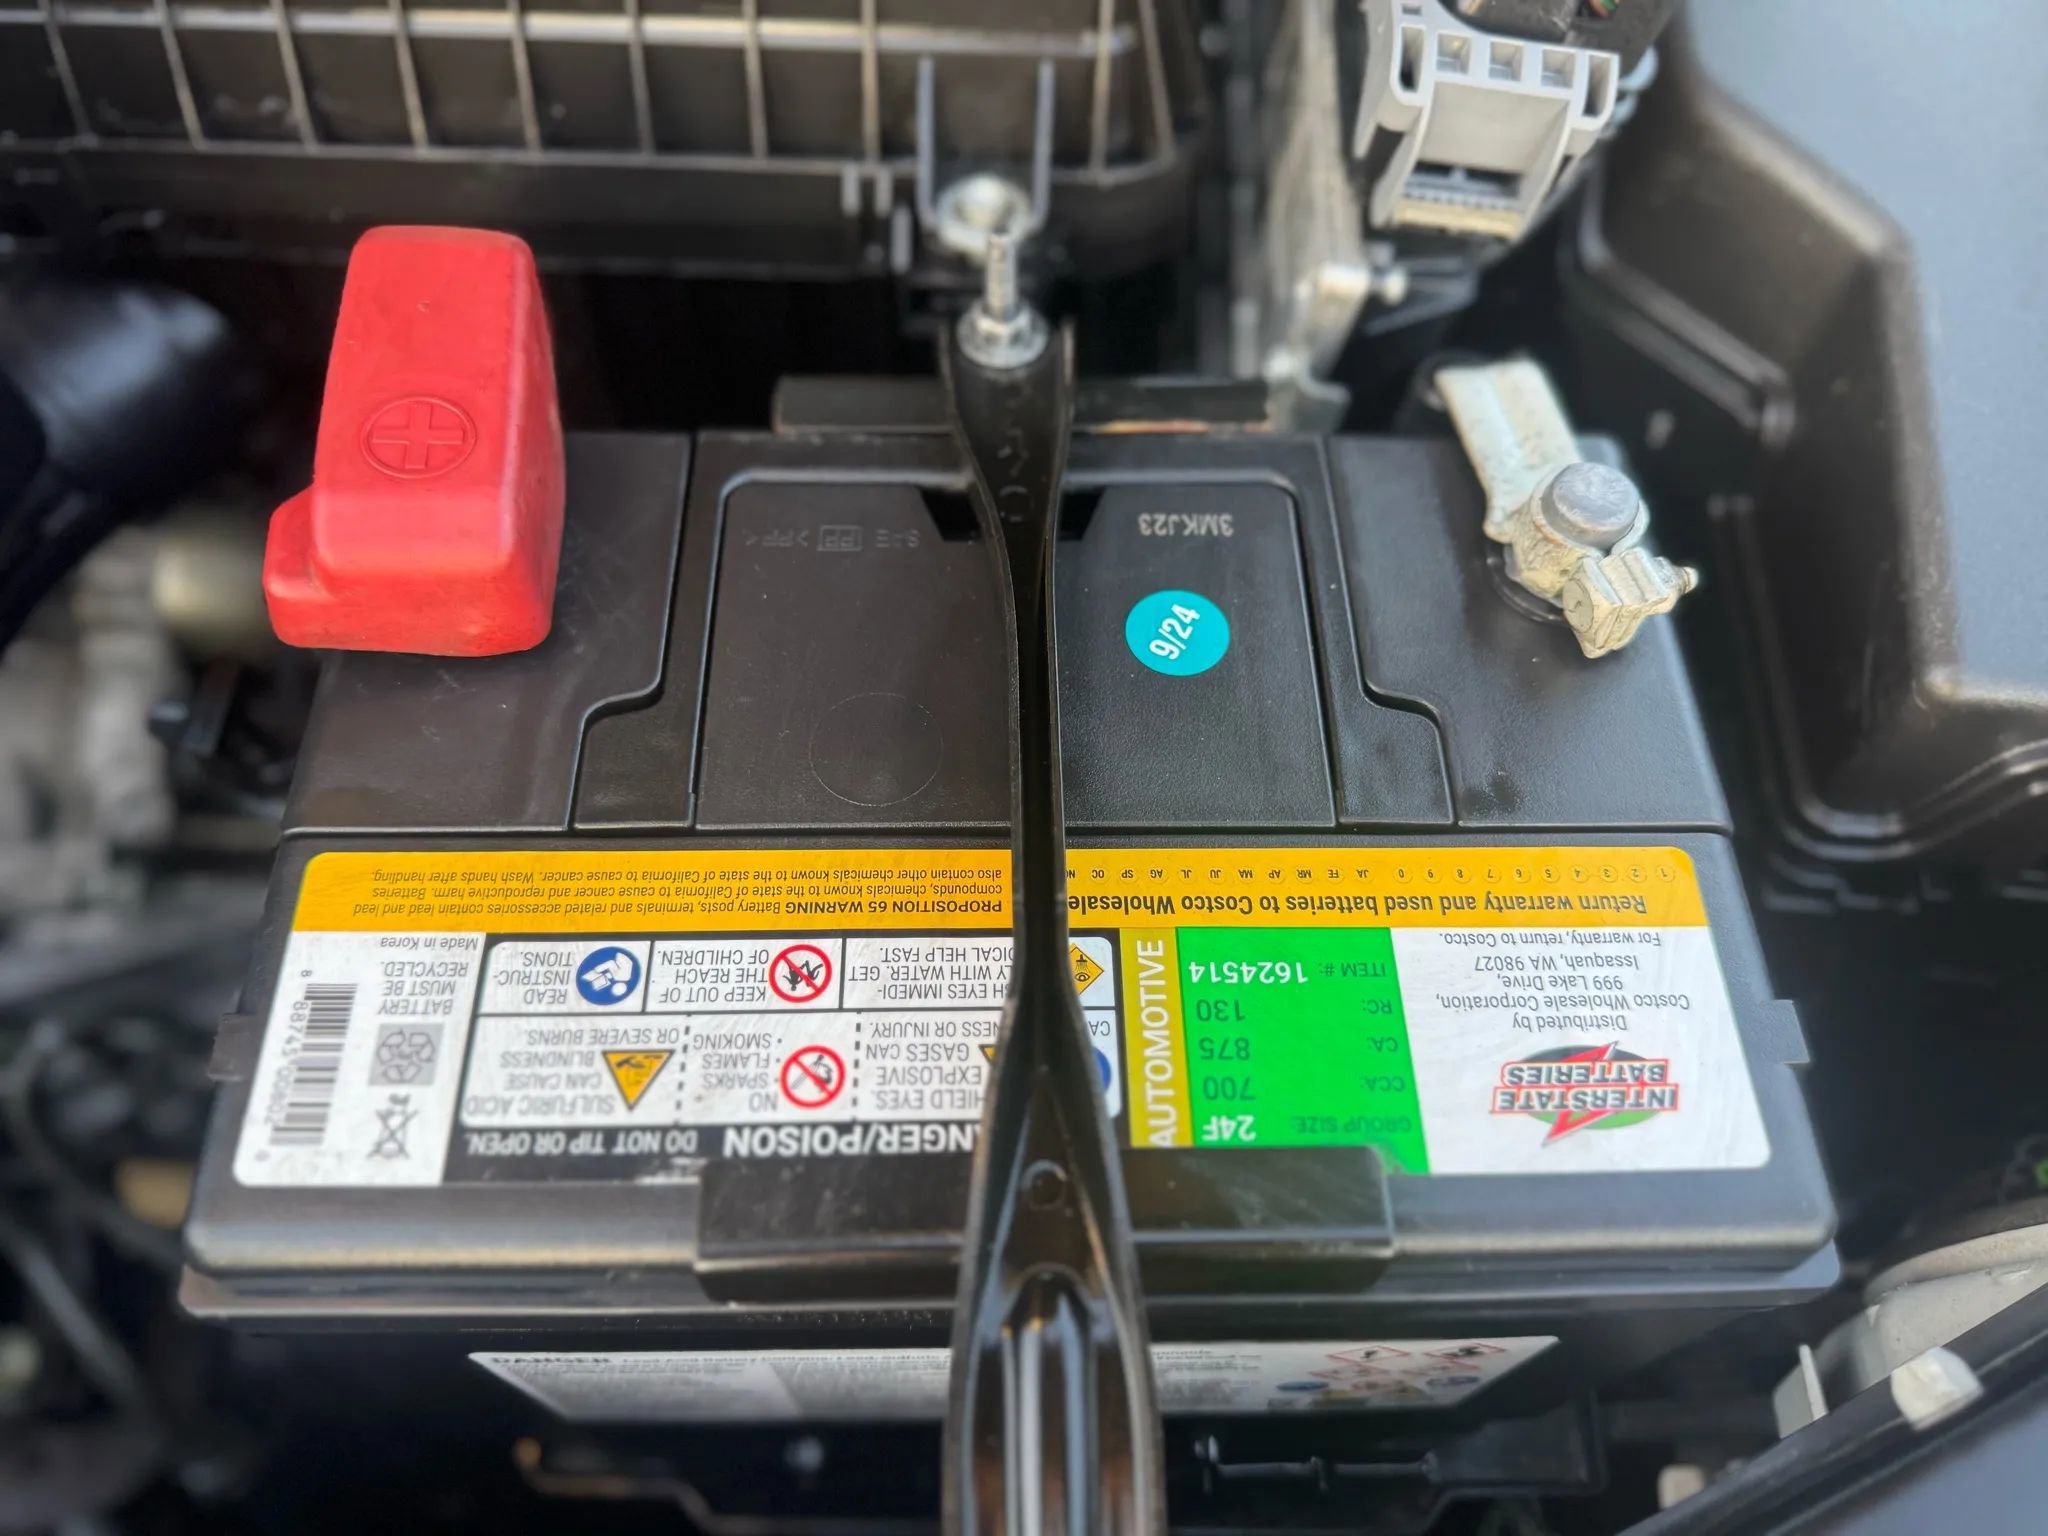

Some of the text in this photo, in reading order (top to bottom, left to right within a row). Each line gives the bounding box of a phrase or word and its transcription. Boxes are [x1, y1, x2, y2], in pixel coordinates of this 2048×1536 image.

[1138, 513, 1234, 538] 3MKJ23
[1148, 602, 1200, 660] 9/24
[371, 869, 1002, 884] also contain other chemicals known to the state of California to cause cancer. Wash hands after handling.
[1092, 868, 1105, 879] OC
[1121, 868, 1134, 879] SP
[1150, 868, 1164, 879] AG
[1180, 868, 1192, 879] JL
[1210, 868, 1222, 879] JU
[1238, 868, 1253, 879] MA
[1268, 868, 1281, 879] AP
[1296, 868, 1312, 879] MR
[1327, 868, 1339, 879] FE
[1356, 868, 1369, 879] JA
[372, 882, 1002, 900] compounds, chemicals known to the state of California to cause cancer and reproductive harm. Batteries
[352, 899, 1002, 917] PROPOSITION 65 WARNING Battery posts, terminals and related accessories contain lead and lead
[1068, 891, 1647, 916] Return warranty and used batteries to Costco Wholesale
[380, 937, 478, 952] Made in Korea
[1439, 930, 1660, 948] For warranty, return to Costco.
[520, 951, 573, 968] TIONS.
[658, 950, 770, 966] OF CHILDREN.
[879, 947, 966, 962] HELP FAST.
[1474, 952, 1638, 972] Issaquah, WA 98027
[380, 961, 469, 978] RECYCLED.
[492, 970, 571, 986] INSTRUC-
[676, 968, 768, 984] THE REACH
[848, 966, 880, 982] GET
[886, 966, 946, 980] WATER.
[950, 966, 992, 980] WITH
[1188, 962, 1386, 984] ITEM #: 1624514
[384, 980, 456, 996] MUST BE
[1496, 972, 1623, 990] 999 Lake Drive,
[524, 988, 568, 1004] READ
[658, 986, 766, 1003] KEEP OUT OF
[876, 984, 942, 999] IMMEDI-
[948, 984, 988, 999] EYES
[378, 998, 454, 1015] BATTERY
[1196, 998, 1392, 1022] RC: 130
[1436, 992, 1690, 1012] Costco Wholesale Corporation,
[869, 1021, 956, 1038] OR INJURY.
[1512, 1012, 1628, 1032] Distributed by
[524, 1028, 680, 1046] OR SEVERE BURNS.
[693, 1033, 772, 1050] SMOKING
[1136, 938, 1177, 1148] AUTOMOTIVE
[866, 1044, 969, 1062] GASES CAN
[1199, 1036, 1398, 1060] CA: 875
[500, 1050, 594, 1068] BLINDNESS
[702, 1052, 770, 1069] FLAMES
[505, 1072, 602, 1090] CAN CAUSE
[704, 1072, 768, 1088] SPARKS
[876, 1066, 982, 1085] EXPLOSIVE
[1506, 1062, 1666, 1086] BATTERIES
[1202, 1076, 1406, 1102] CCA: 700
[466, 1094, 614, 1116] SULFURIC ACID
[750, 1092, 778, 1111] NO
[870, 1089, 924, 1110] EYES.
[1498, 1088, 1678, 1110] INTERSTATE
[1202, 1114, 1257, 1140] 24F
[1344, 1116, 1412, 1132] GROUP
[464, 1124, 980, 1158] NGER/POISON DO NOT TIP OR OPEN.
